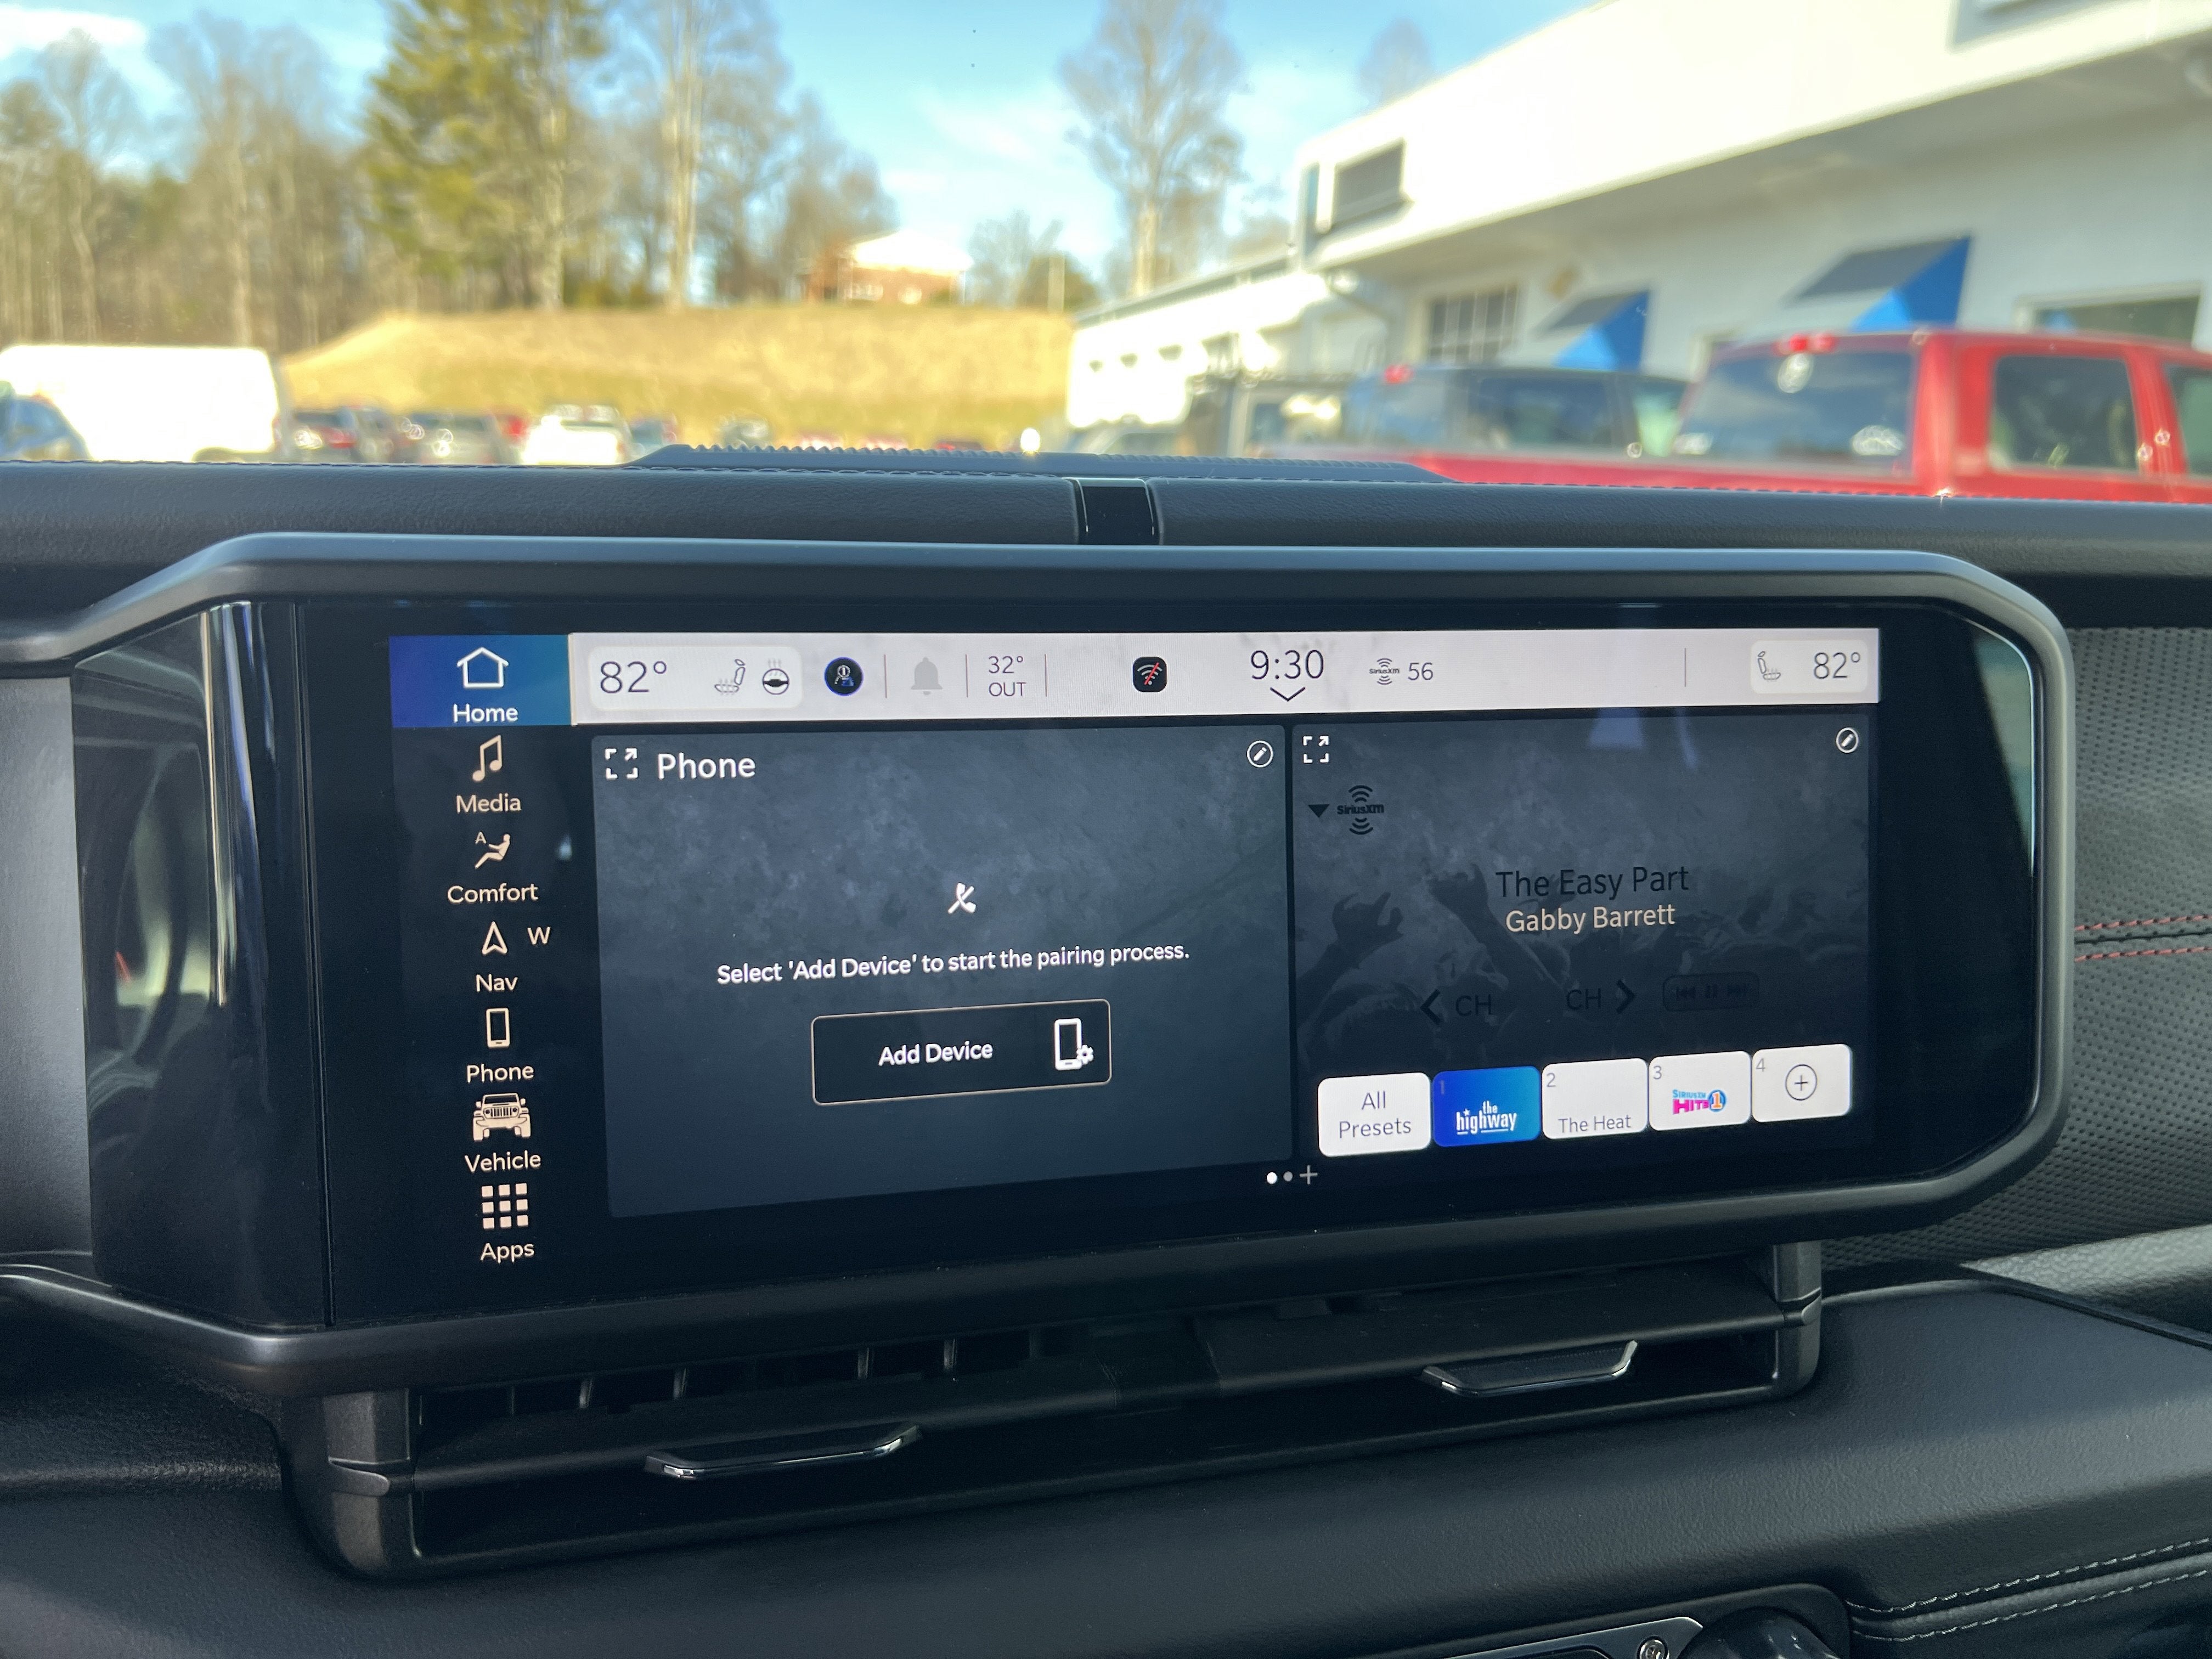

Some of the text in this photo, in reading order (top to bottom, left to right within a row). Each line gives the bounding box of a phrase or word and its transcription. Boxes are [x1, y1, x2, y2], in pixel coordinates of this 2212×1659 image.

[1250, 650, 1324, 680] 9:30
[1408, 662, 1434, 681] 56
[988, 681, 1026, 697] OUT
[453, 703, 518, 723] Home
[658, 752, 756, 780] Phone
[456, 793, 522, 813] Media
[447, 883, 539, 903] Comfort
[1496, 866, 1689, 900] The Easy Part
[1505, 904, 1675, 934] Gabby Barrett
[527, 927, 550, 945] W
[717, 961, 783, 985] Select
[922, 955, 944, 973] to
[948, 952, 996, 971] start
[1000, 949, 1032, 969] the
[1037, 945, 1105, 970] pairing
[1110, 944, 1189, 964] process.
[475, 974, 518, 992] Nav
[1455, 995, 1492, 1016] CH
[1566, 989, 1601, 1011] CH
[878, 1040, 994, 1066] Add Device
[466, 1064, 534, 1082] Phone
[1652, 1066, 1662, 1080] 3
[1756, 1058, 1765, 1073] 4
[1440, 1080, 1445, 1095] 1
[1547, 1073, 1556, 1087] 2
[1361, 1091, 1386, 1110] All
[1482, 1101, 1498, 1114] the
[1711, 1092, 1723, 1109] 1
[1339, 1118, 1412, 1138] Presets
[1456, 1108, 1517, 1135] highway
[1558, 1114, 1632, 1133] The Heat
[464, 1151, 541, 1172] Vehicle
[480, 1242, 535, 1265] Apps
